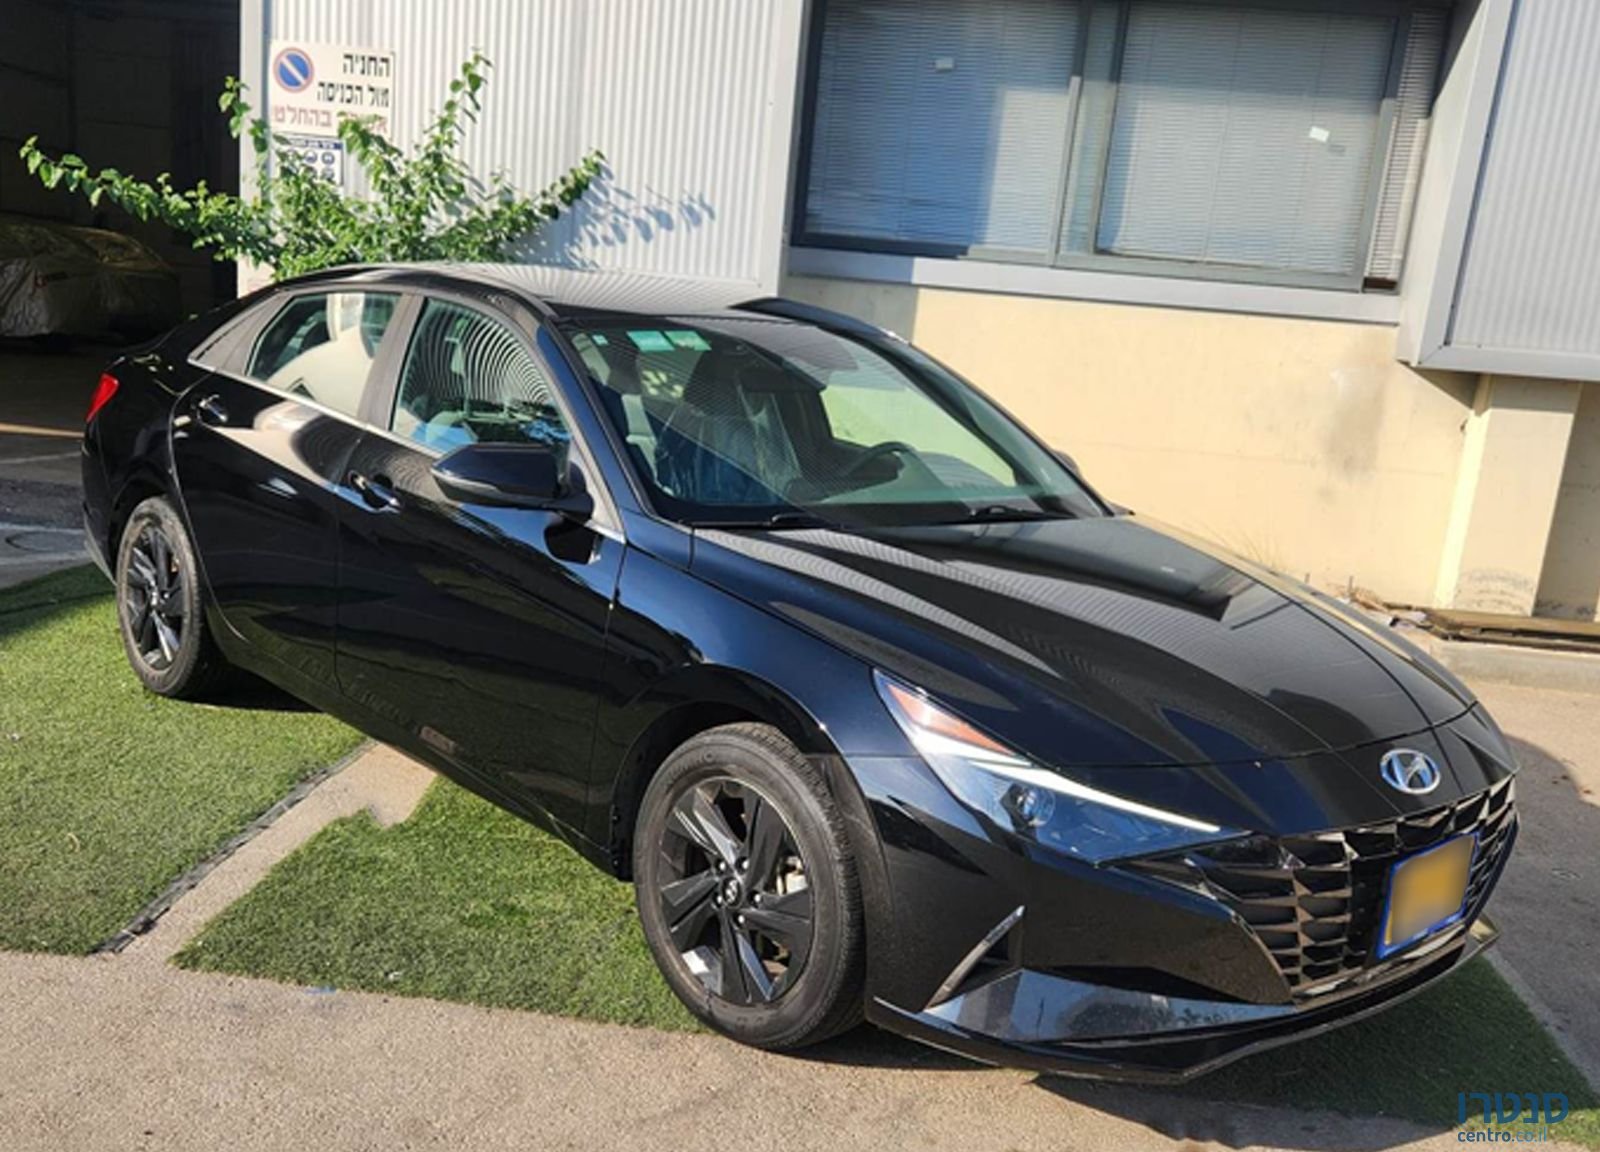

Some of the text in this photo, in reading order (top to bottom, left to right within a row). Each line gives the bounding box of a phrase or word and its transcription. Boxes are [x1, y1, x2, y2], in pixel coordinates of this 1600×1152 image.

[343, 53, 389, 76] החניה
[317, 81, 389, 107] מול הכניסה
